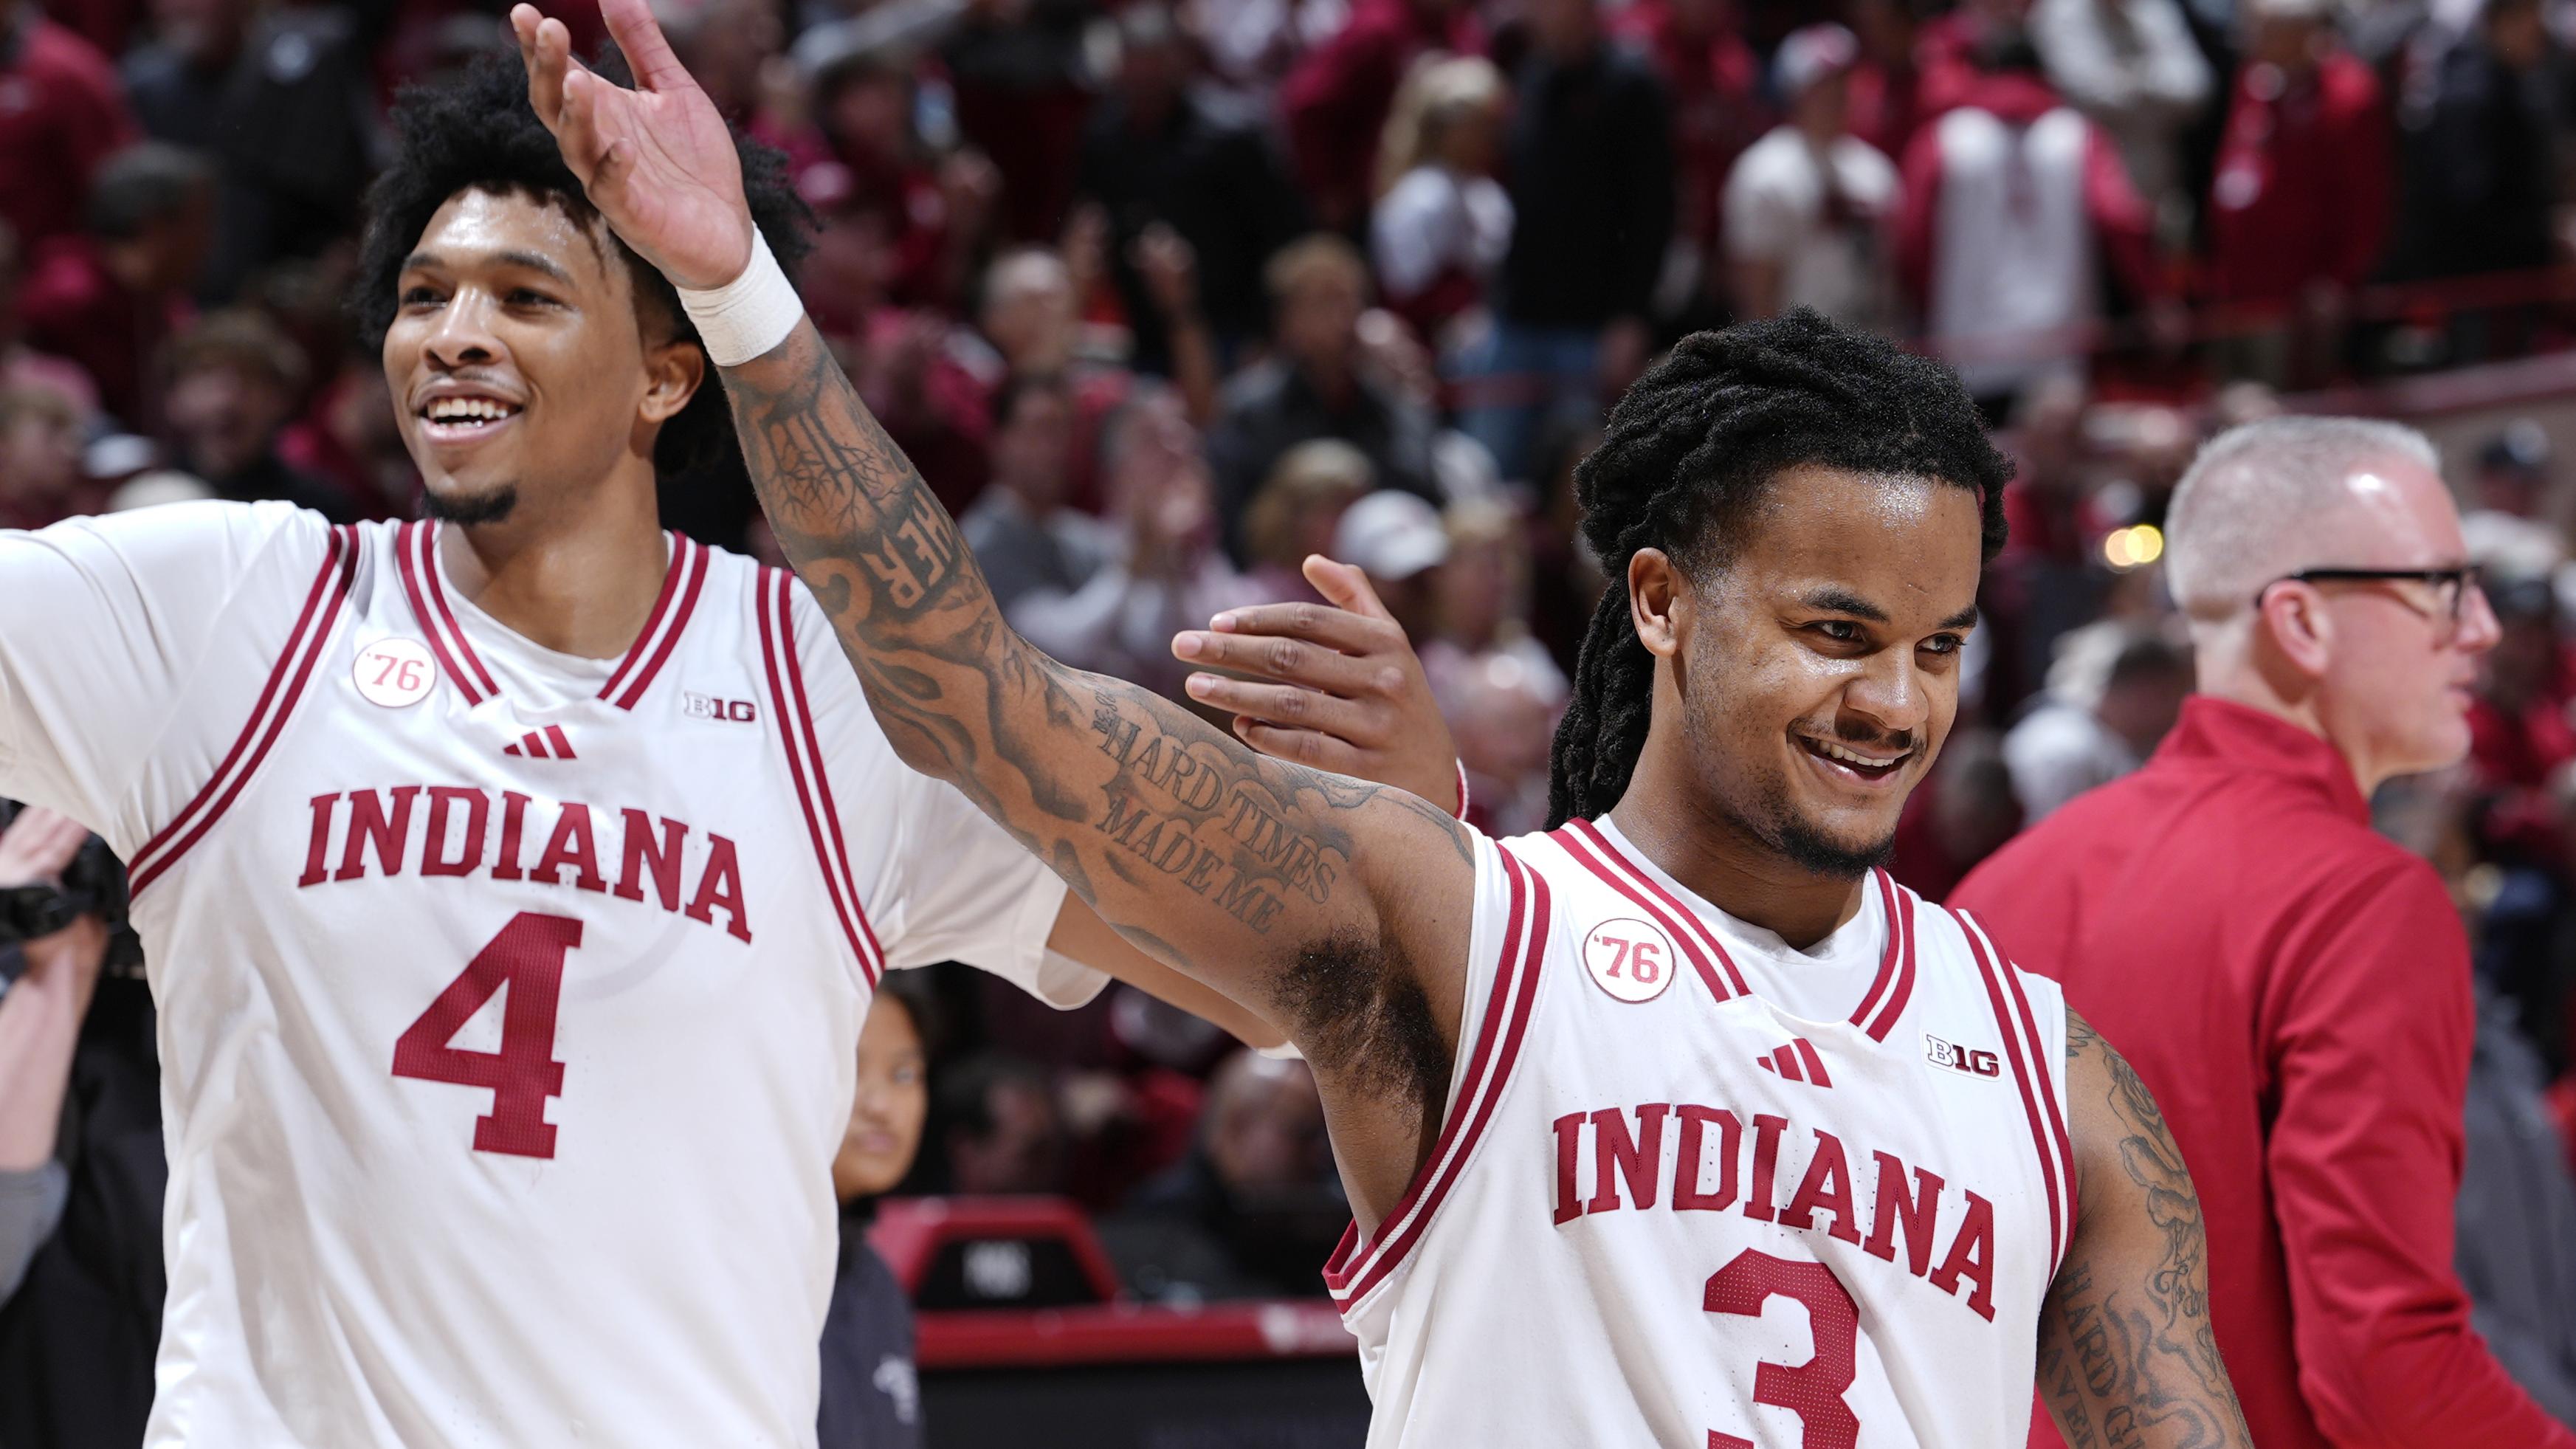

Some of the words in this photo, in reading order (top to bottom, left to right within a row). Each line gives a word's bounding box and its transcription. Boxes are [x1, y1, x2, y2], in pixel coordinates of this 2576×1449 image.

[298, 785, 753, 946] INDIANA
[1095, 794, 1225, 895] MADE
[1212, 868, 1284, 935] ME
[1098, 715, 1223, 813] HARD
[1222, 788, 1336, 905] TIMES
[391, 911, 584, 1160] 4
[1552, 1102, 1997, 1324] INDIANA
[1702, 1247, 1860, 1449] 3
